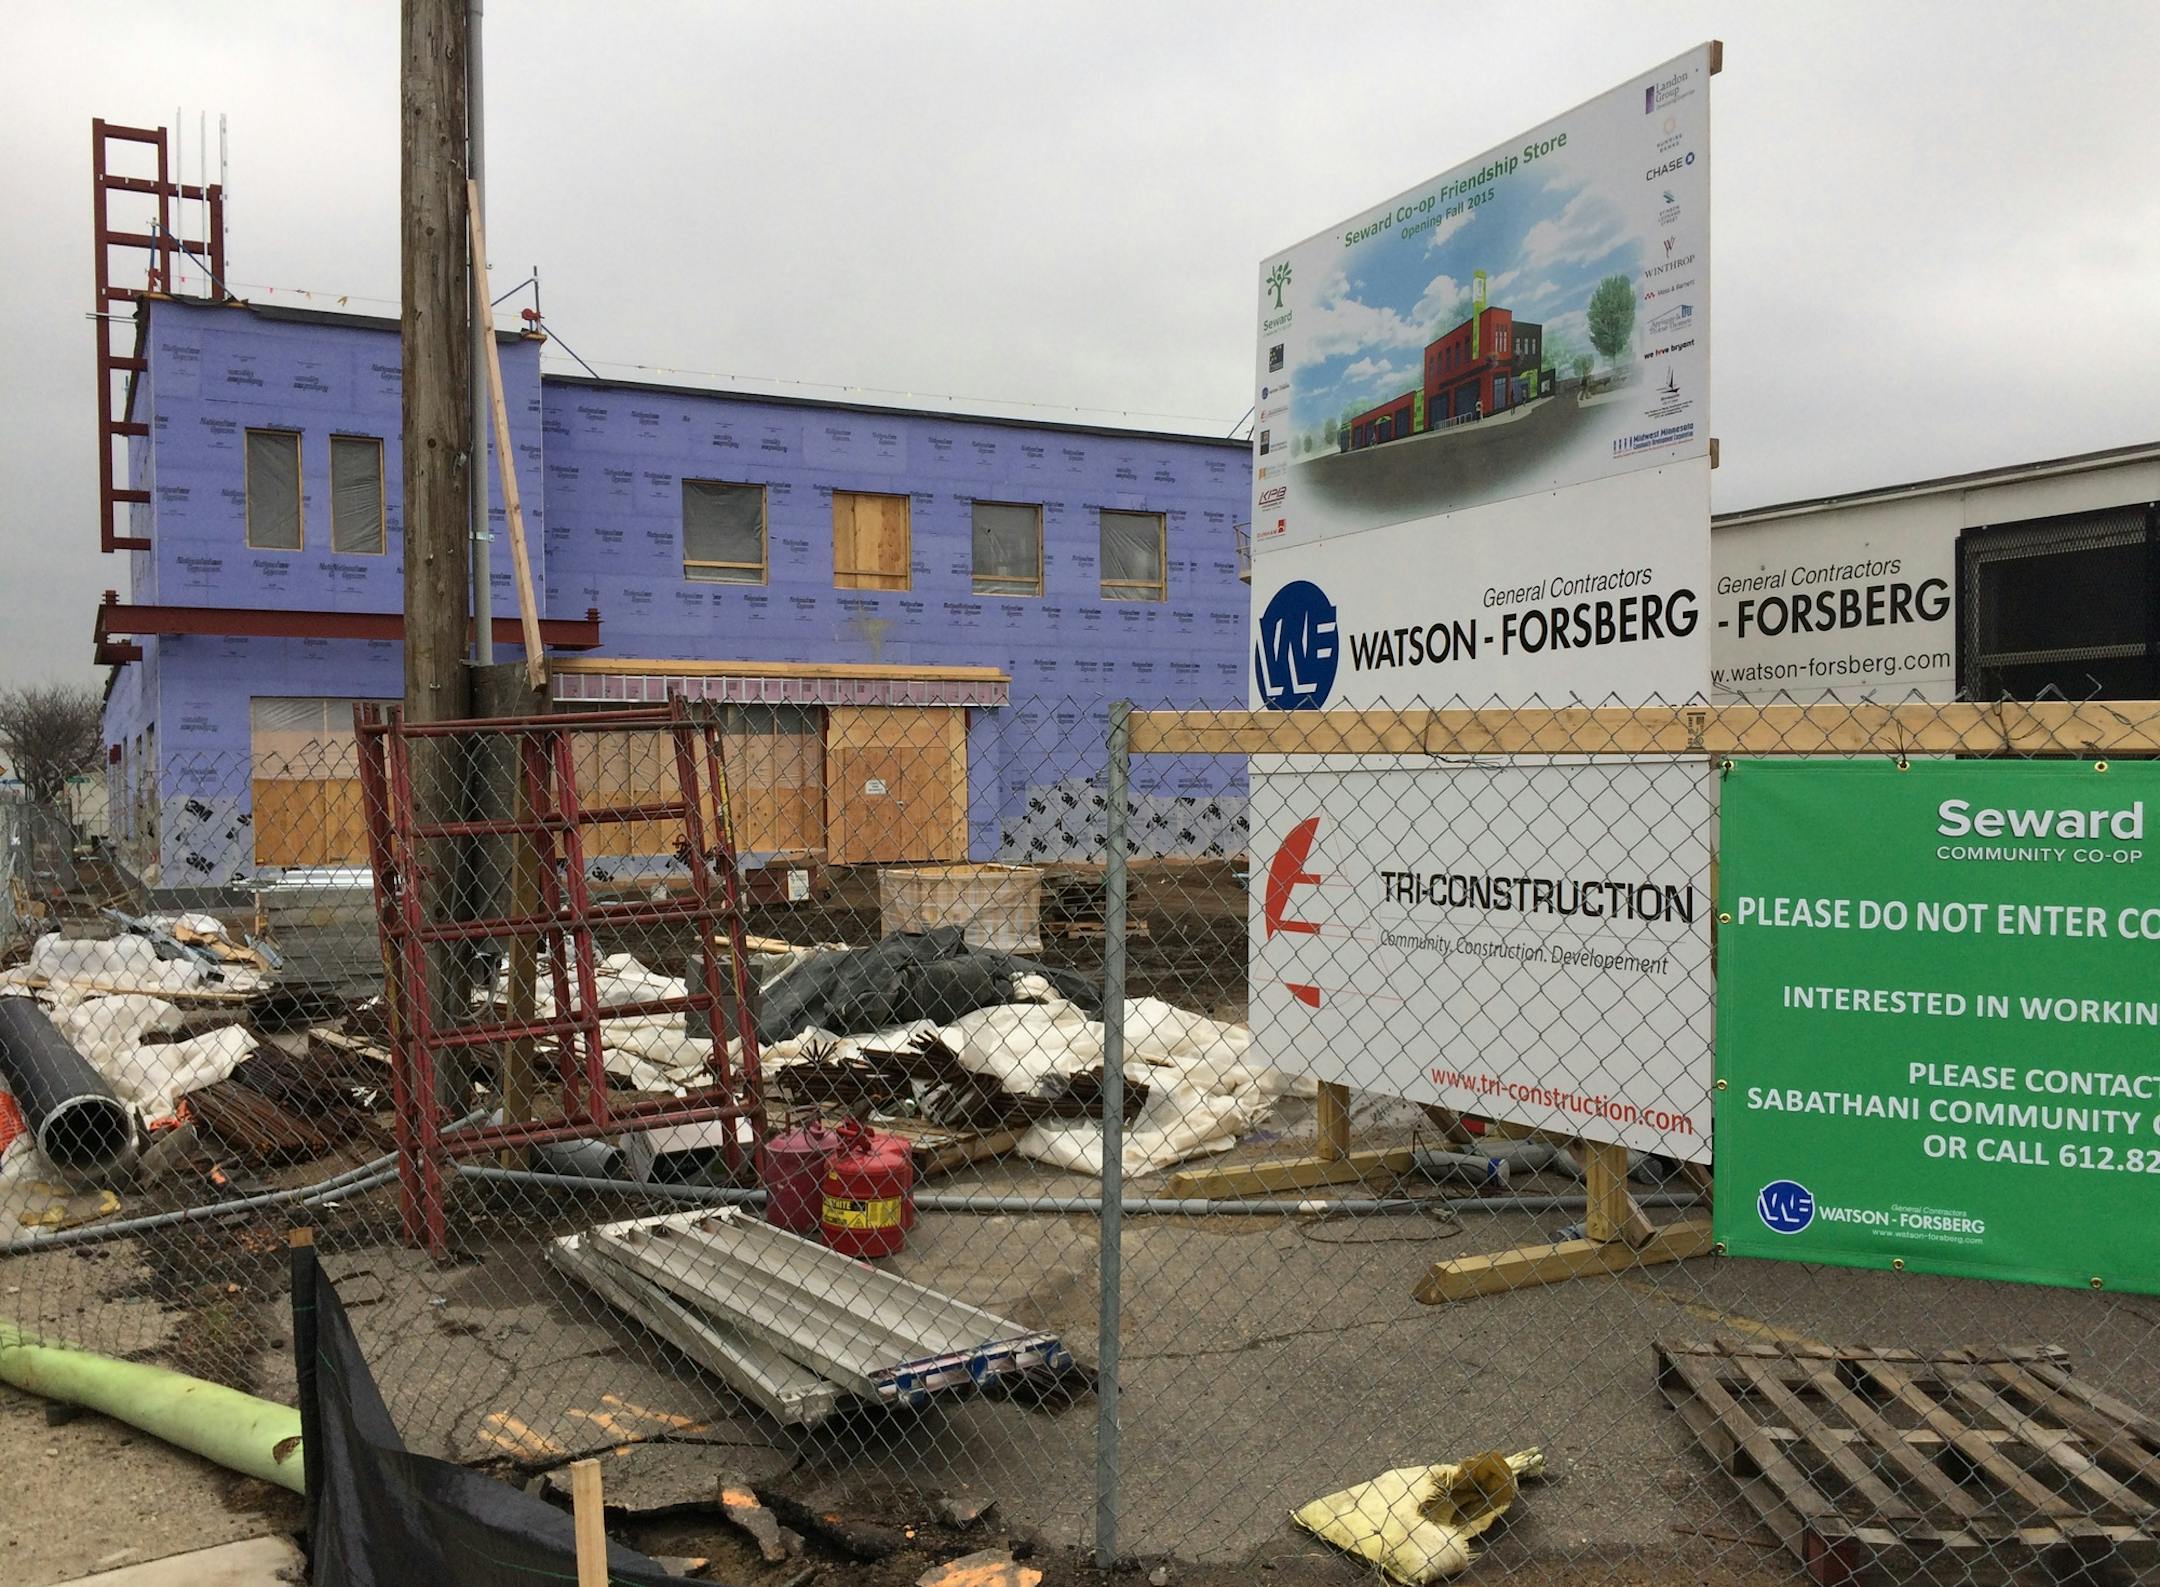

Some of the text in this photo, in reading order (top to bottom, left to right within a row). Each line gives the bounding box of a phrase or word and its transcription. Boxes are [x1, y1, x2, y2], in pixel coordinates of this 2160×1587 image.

[1655, 87, 1680, 103] Group
[1656, 73, 1688, 93] Landon
[1646, 157, 1683, 181] CHASE
[1345, 132, 1568, 247] Seward Co-op Friendship Store
[1401, 188, 1494, 240] Opening Fall 2015
[1645, 254, 1695, 278] WINTHROP
[1263, 310, 1292, 332] Seward
[1483, 568, 1653, 609] General Contractors
[1717, 559, 1902, 595] General Contractors
[1738, 578, 1951, 638] FORSBERG
[1350, 619, 1478, 671] WATSON
[1502, 588, 1699, 656] FORSBERG
[1937, 799, 2144, 840] Seward
[1936, 846, 2143, 864] COMMUNITY CO-OP
[1381, 871, 1693, 924] TRI-CONSTRUCTION
[1737, 896, 1851, 929] PLEASE
[1859, 900, 1908, 931] DO
[1917, 902, 1988, 934] NOT
[1998, 905, 2107, 939] ENTER
[1551, 945, 1669, 975] Developement
[1783, 986, 2158, 1026] INTERESTED IN WORKIN
[1909, 1063, 2015, 1091] PLEASE
[1431, 1068, 1693, 1136] www.tri-construction.com
[1747, 1087, 1920, 1121] SABATHANI
[1929, 1099, 2141, 1136] COMMUNITY
[1923, 1134, 1968, 1160] OR
[1976, 1138, 2050, 1166] CALL
[1819, 1206, 1889, 1226] WATSON
[1900, 1213, 1985, 1234] FORSBERG
[1890, 1203, 1967, 1218] General Contractors
[1872, 1228, 1984, 1245] www.watson-forsberg.com
